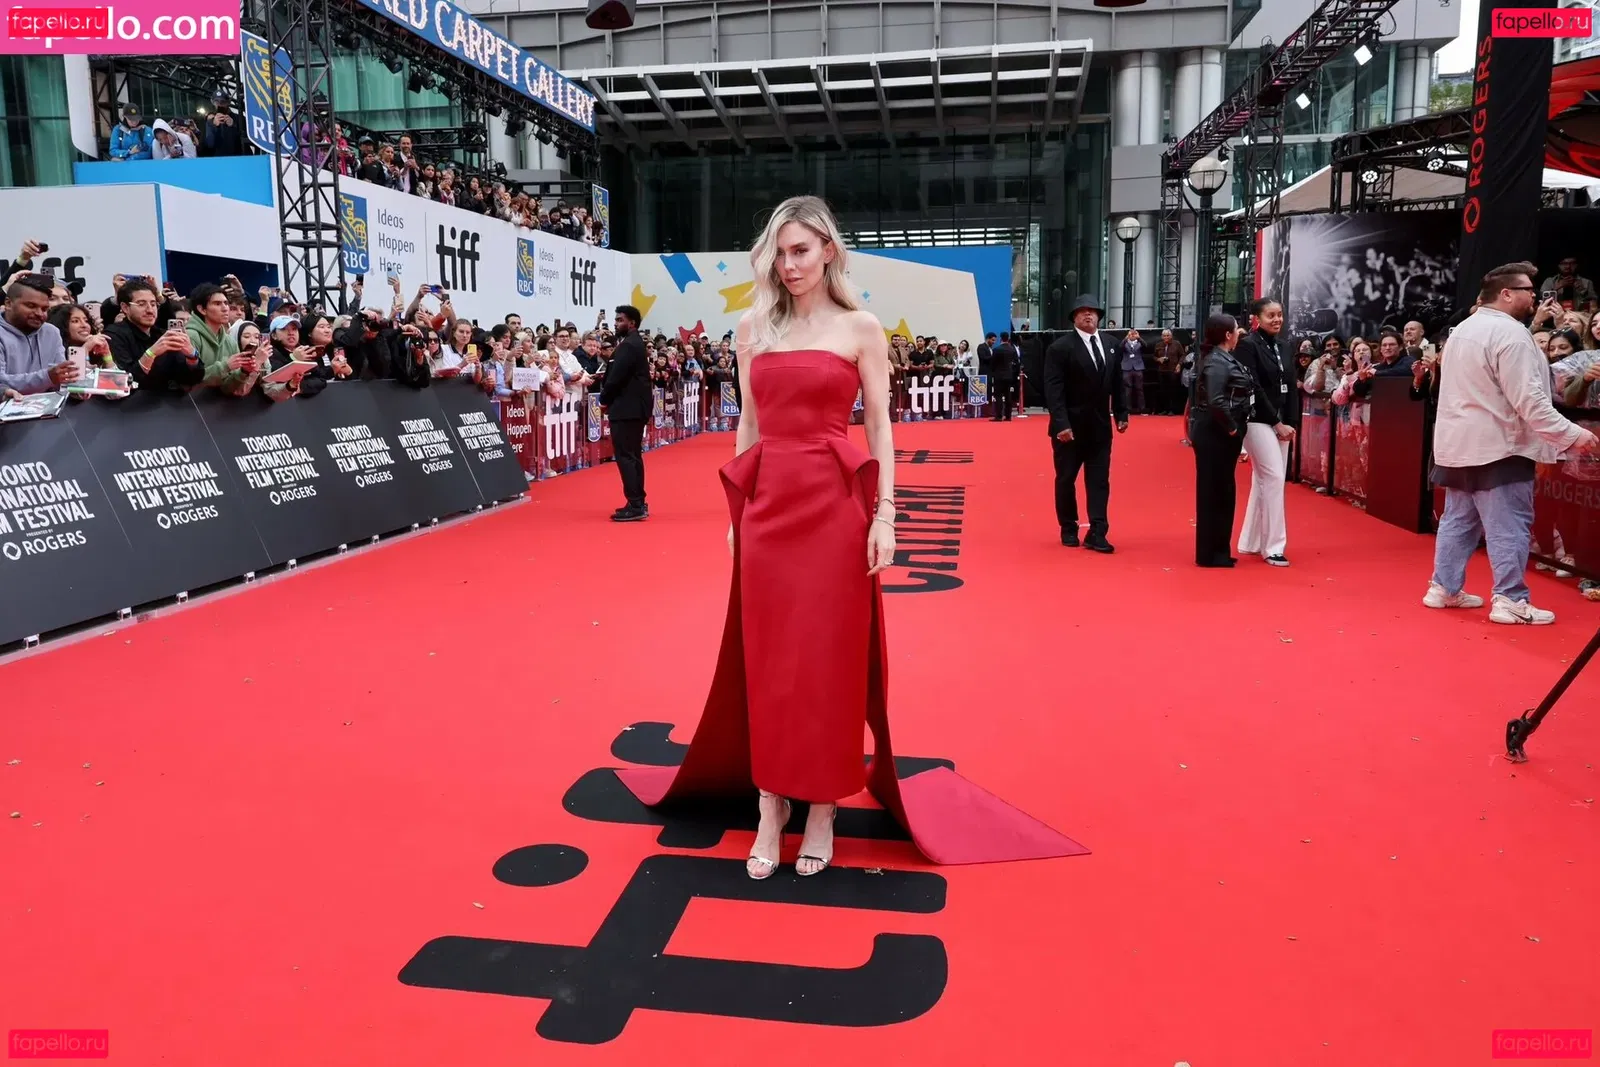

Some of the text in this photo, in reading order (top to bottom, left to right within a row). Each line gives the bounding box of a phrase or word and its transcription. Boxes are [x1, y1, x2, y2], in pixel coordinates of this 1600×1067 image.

[435, 0, 520, 85] CARPET
[524, 57, 598, 127] GALLERY
[1469, 35, 1493, 188] ROGERS
[377, 209, 404, 229] Ideas
[378, 232, 415, 256] Happen
[343, 251, 367, 270] RBC
[380, 257, 402, 274] Here
[436, 224, 480, 292] tiff
[539, 248, 554, 262] Ideas
[539, 265, 560, 281] Happen
[570, 256, 597, 307] tiff
[519, 280, 533, 293] RBC
[539, 284, 552, 295] Here
[908, 375, 954, 413] tiff
[506, 404, 525, 418] Ideas
[683, 382, 700, 428] tiff
[331, 424, 372, 442] TORONTO
[401, 418, 434, 433] TORONTO
[506, 423, 532, 438] Happen
[543, 392, 578, 460] tiff
[241, 433, 293, 454] TORONTO
[326, 437, 390, 459] INTERNATIONAL
[398, 429, 449, 448] INTERNATIONAL
[464, 433, 504, 450] FILM FESTIVAL
[510, 442, 524, 453] ere
[123, 445, 190, 469] TORONTO
[235, 447, 315, 473] INTERNATIONAL
[336, 451, 395, 473] FILM FESTIVAL
[406, 442, 454, 461] FILM FESTIVAL
[0, 461, 53, 487] ONTO
[113, 461, 218, 492] INTERNATIONAL
[246, 463, 320, 489] FILM FESTIVAL
[429, 460, 453, 472] ROGERS
[363, 470, 393, 485] ROGERS
[0, 479, 89, 510] NATIONAL
[126, 480, 224, 511] FILM FESTIVAL
[280, 485, 317, 502] ROGERS
[12, 500, 96, 531] FESTIVAL
[171, 505, 219, 525] ROGERS
[22, 530, 87, 556] ROGERS
